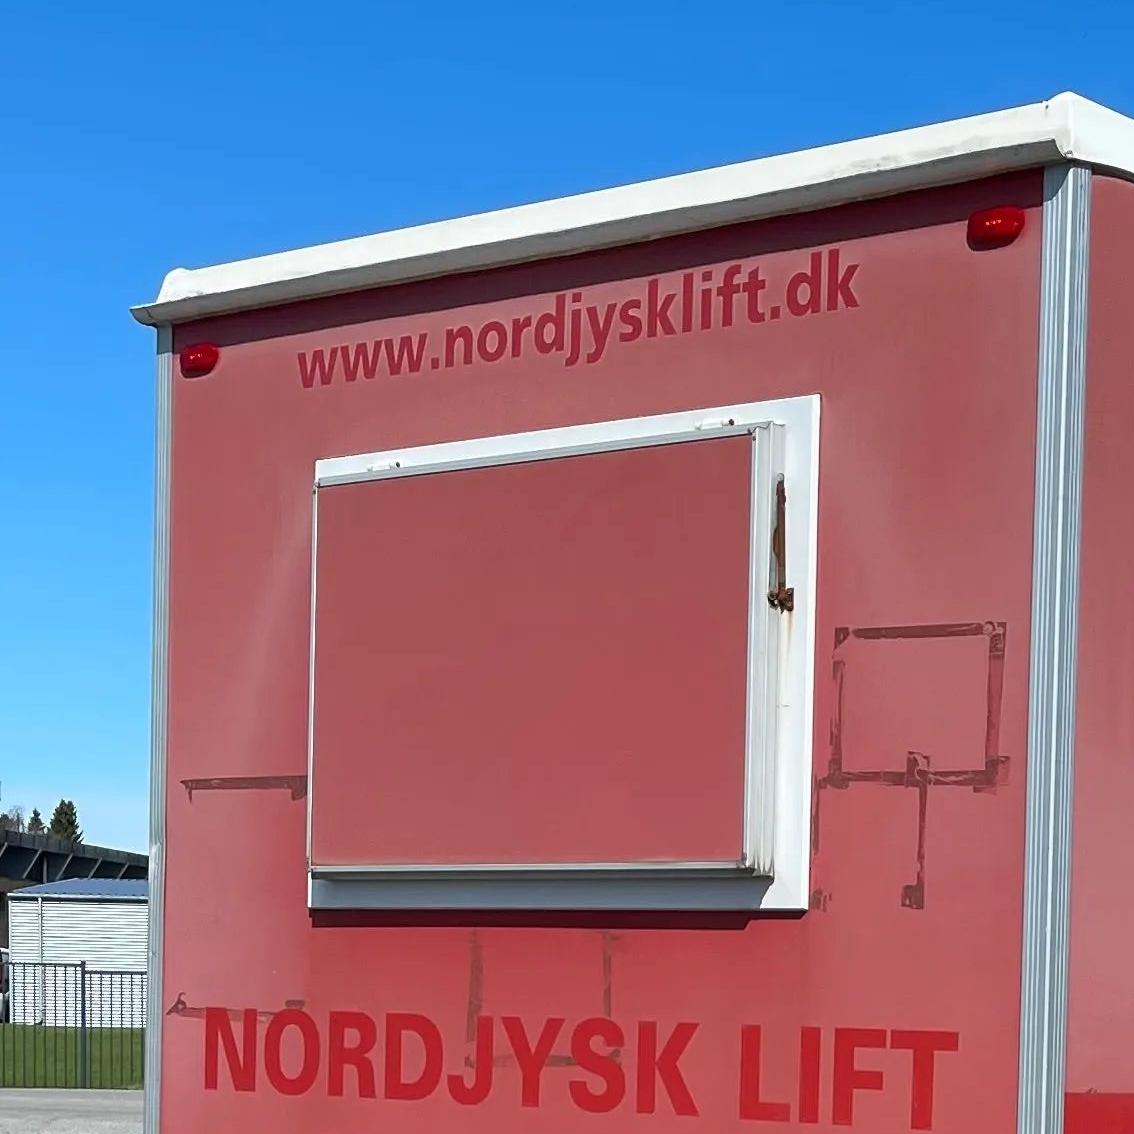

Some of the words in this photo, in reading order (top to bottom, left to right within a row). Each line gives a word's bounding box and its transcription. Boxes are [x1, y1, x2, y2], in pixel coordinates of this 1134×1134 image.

[297, 248, 861, 389] www.nordjysklift.dk
[203, 1007, 700, 1118] NORDJYSK
[737, 1024, 961, 1132] LIFT
